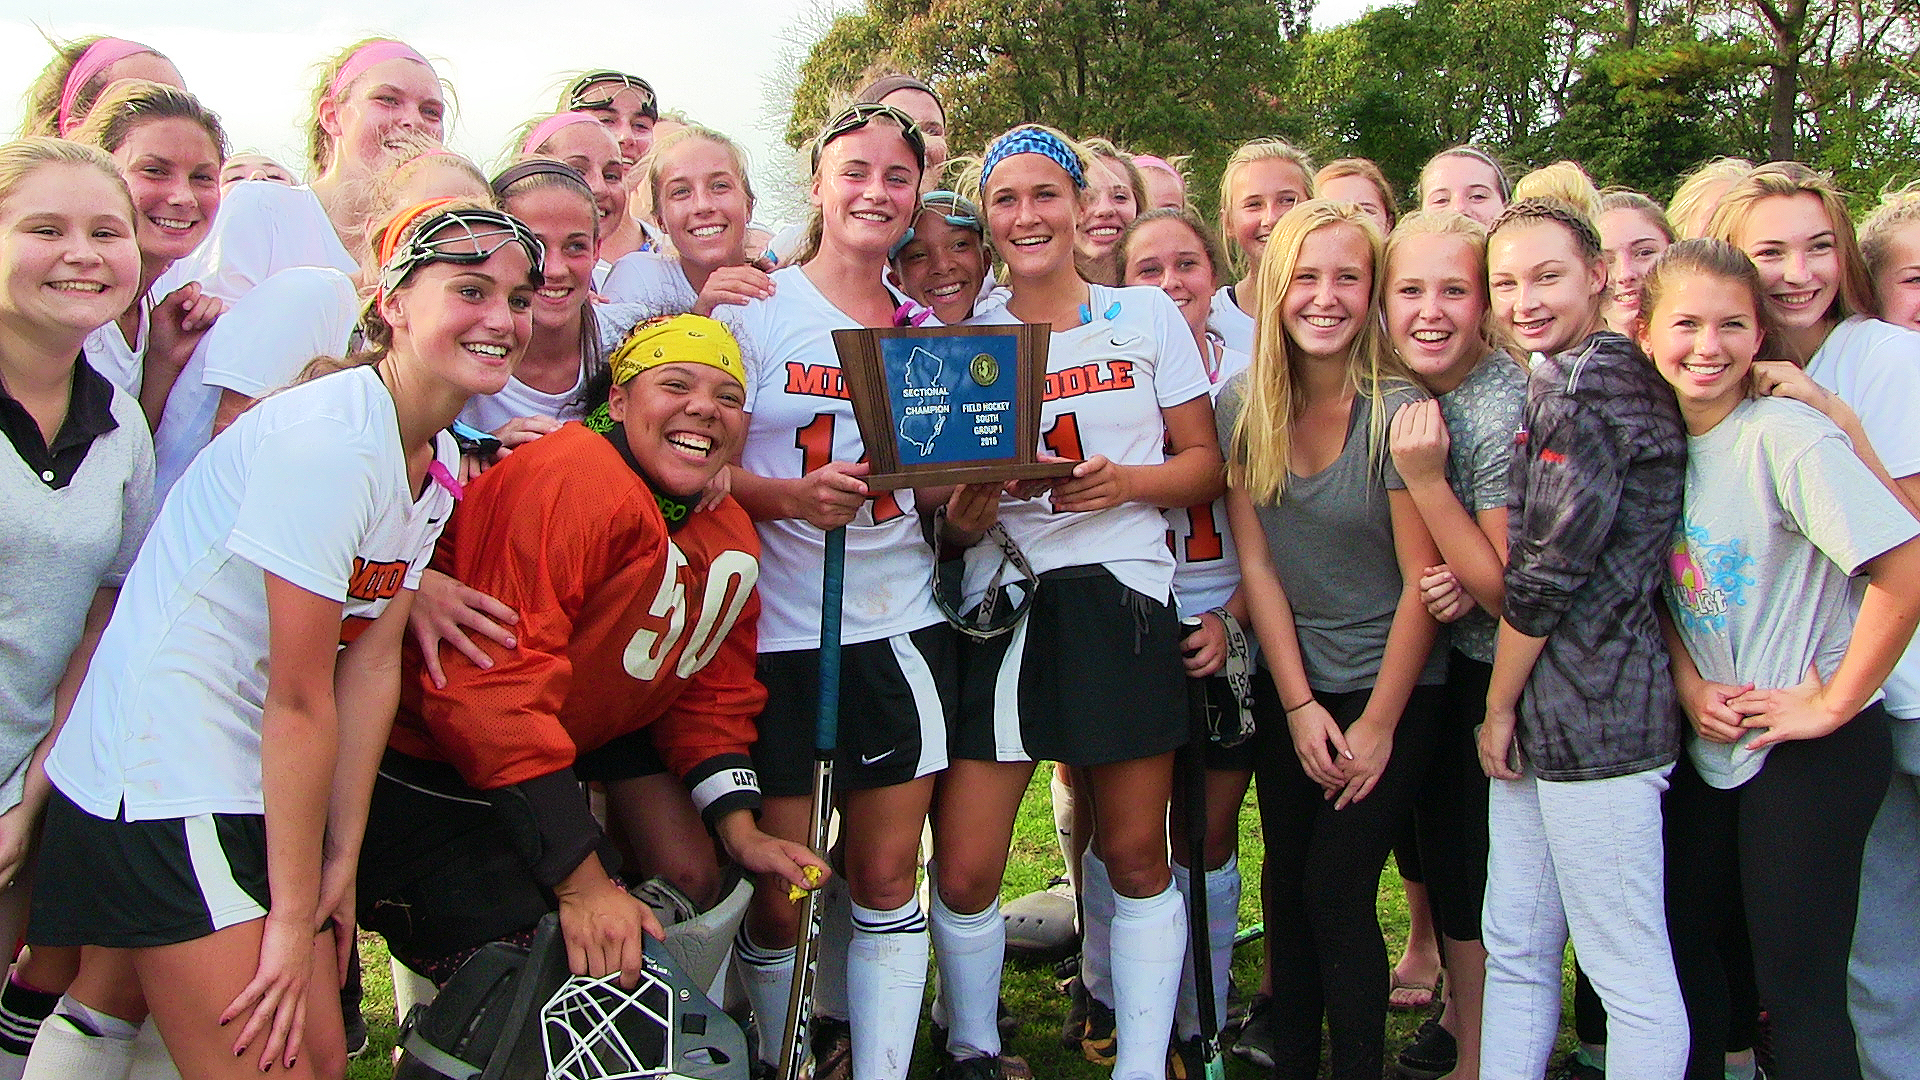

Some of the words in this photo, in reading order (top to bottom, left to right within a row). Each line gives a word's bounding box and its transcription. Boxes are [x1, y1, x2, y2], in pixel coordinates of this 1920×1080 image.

[902, 387, 950, 397] SECTIONAL
[905, 404, 950, 415] CHAMPION
[962, 403, 982, 412] FIELD
[982, 401, 1010, 412] HOCKEY
[975, 413, 999, 424] SOUTH
[973, 425, 999, 435] GROUP
[623, 537, 760, 680] 50
